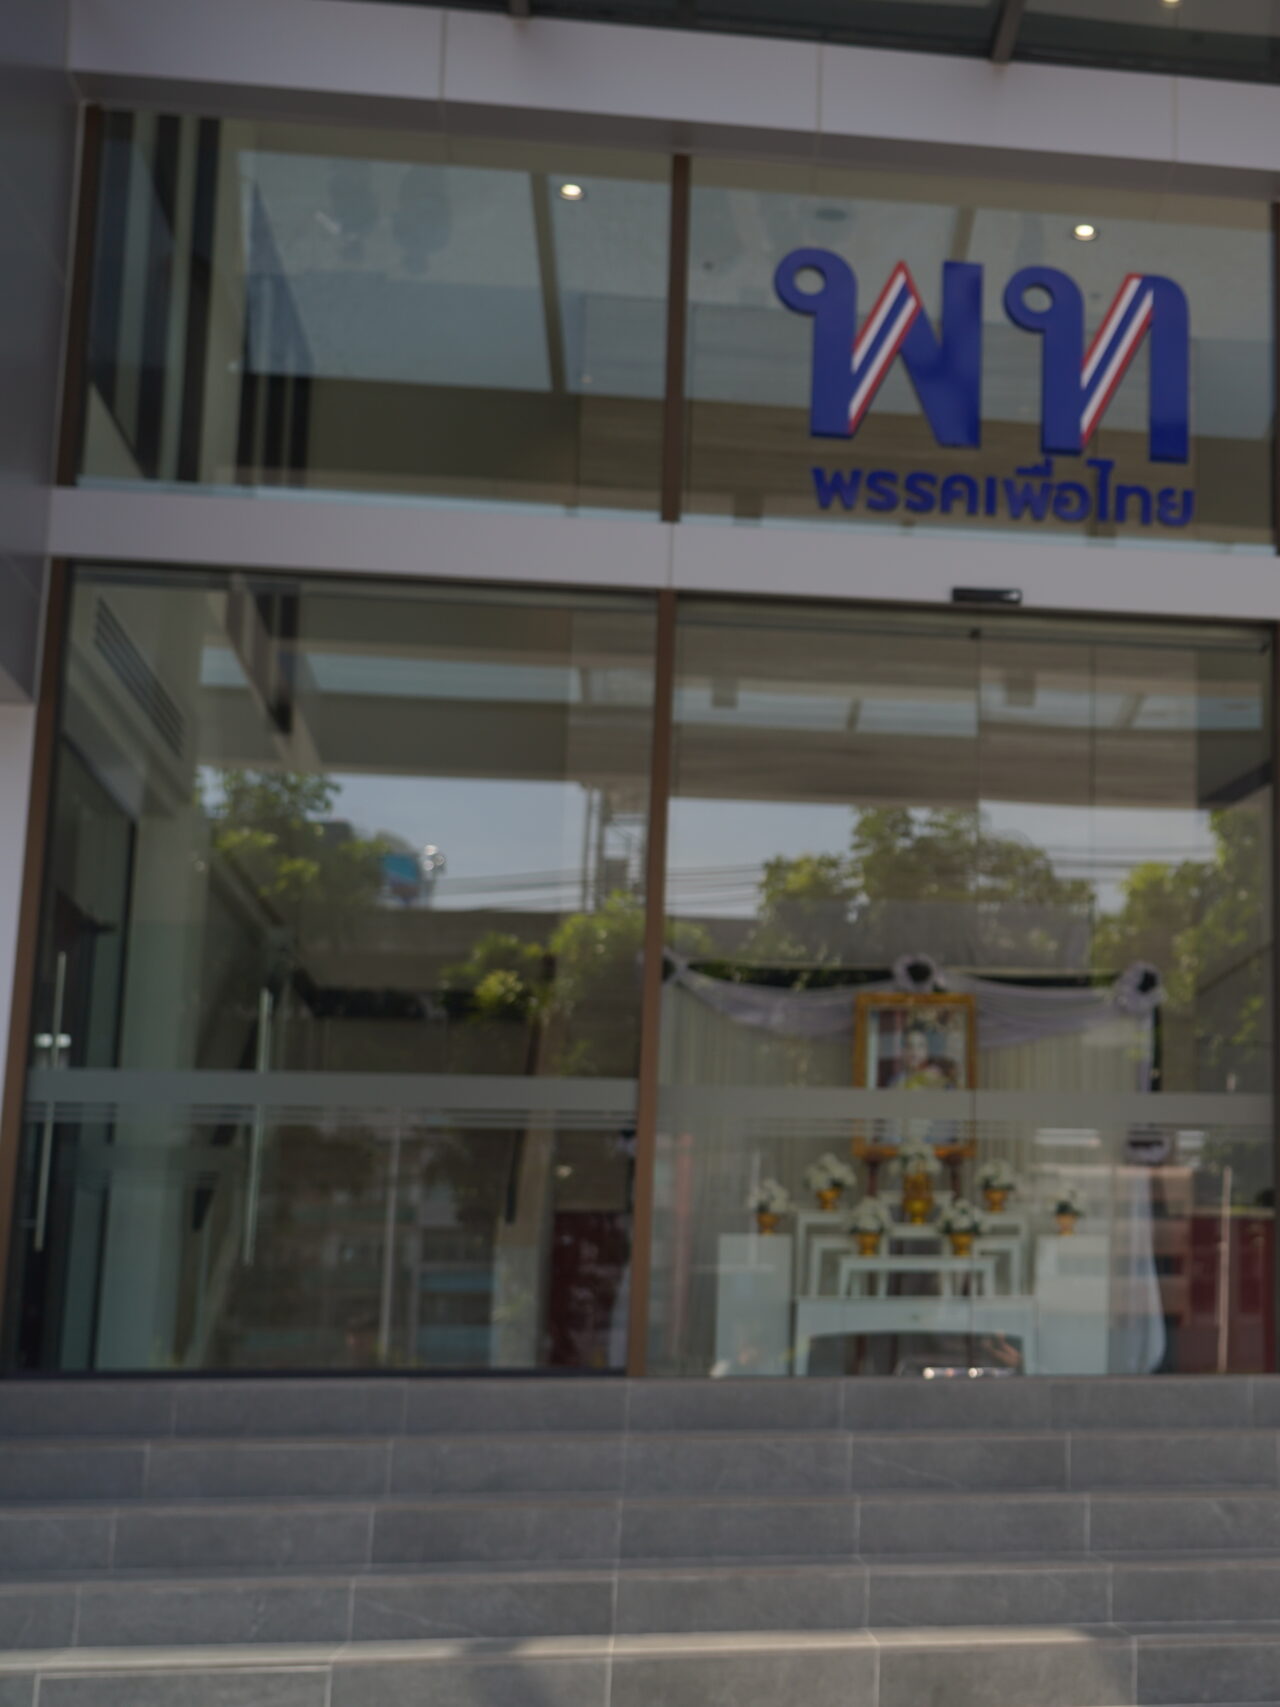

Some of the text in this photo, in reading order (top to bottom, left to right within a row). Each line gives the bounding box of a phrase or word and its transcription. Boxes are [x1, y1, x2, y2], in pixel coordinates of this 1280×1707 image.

[773, 247, 1190, 463] พท
[811, 456, 1195, 527] พรรคเพื่อไทย
